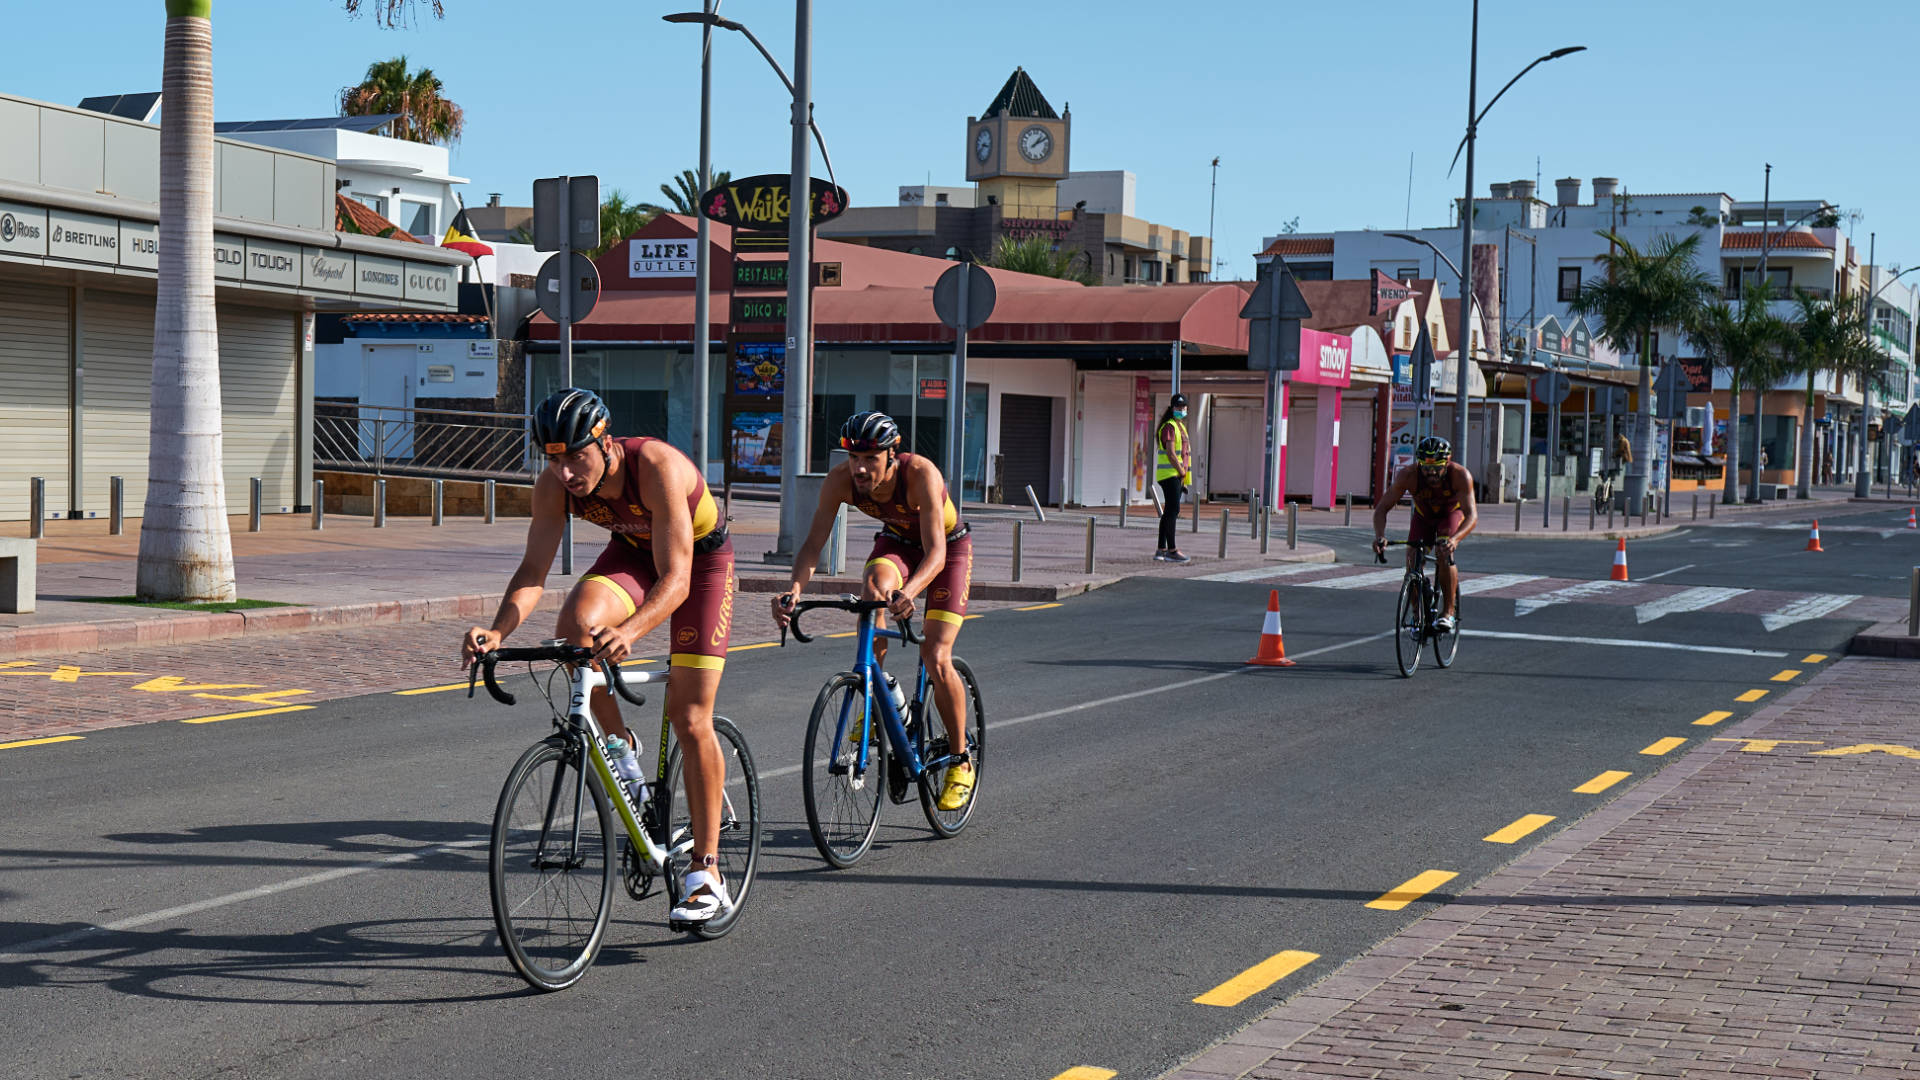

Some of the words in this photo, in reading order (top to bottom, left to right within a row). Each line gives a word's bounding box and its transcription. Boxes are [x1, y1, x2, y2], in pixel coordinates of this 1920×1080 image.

[17, 221, 40, 238] Ross
[65, 231, 116, 249] BREITLING
[133, 237, 159, 254] HUBL
[214, 247, 242, 265] OLD
[250, 252, 293, 272] TOUCH
[641, 243, 689, 259] LIFE
[311, 255, 347, 282] Chopard
[633, 261, 696, 272] OUTLET
[737, 267, 789, 282] RESTAURA
[361, 269, 400, 286] LONGINES
[409, 274, 447, 292] GUCCI
[1380, 288, 1409, 299] WENDY
[744, 303, 772, 318] DISCO
